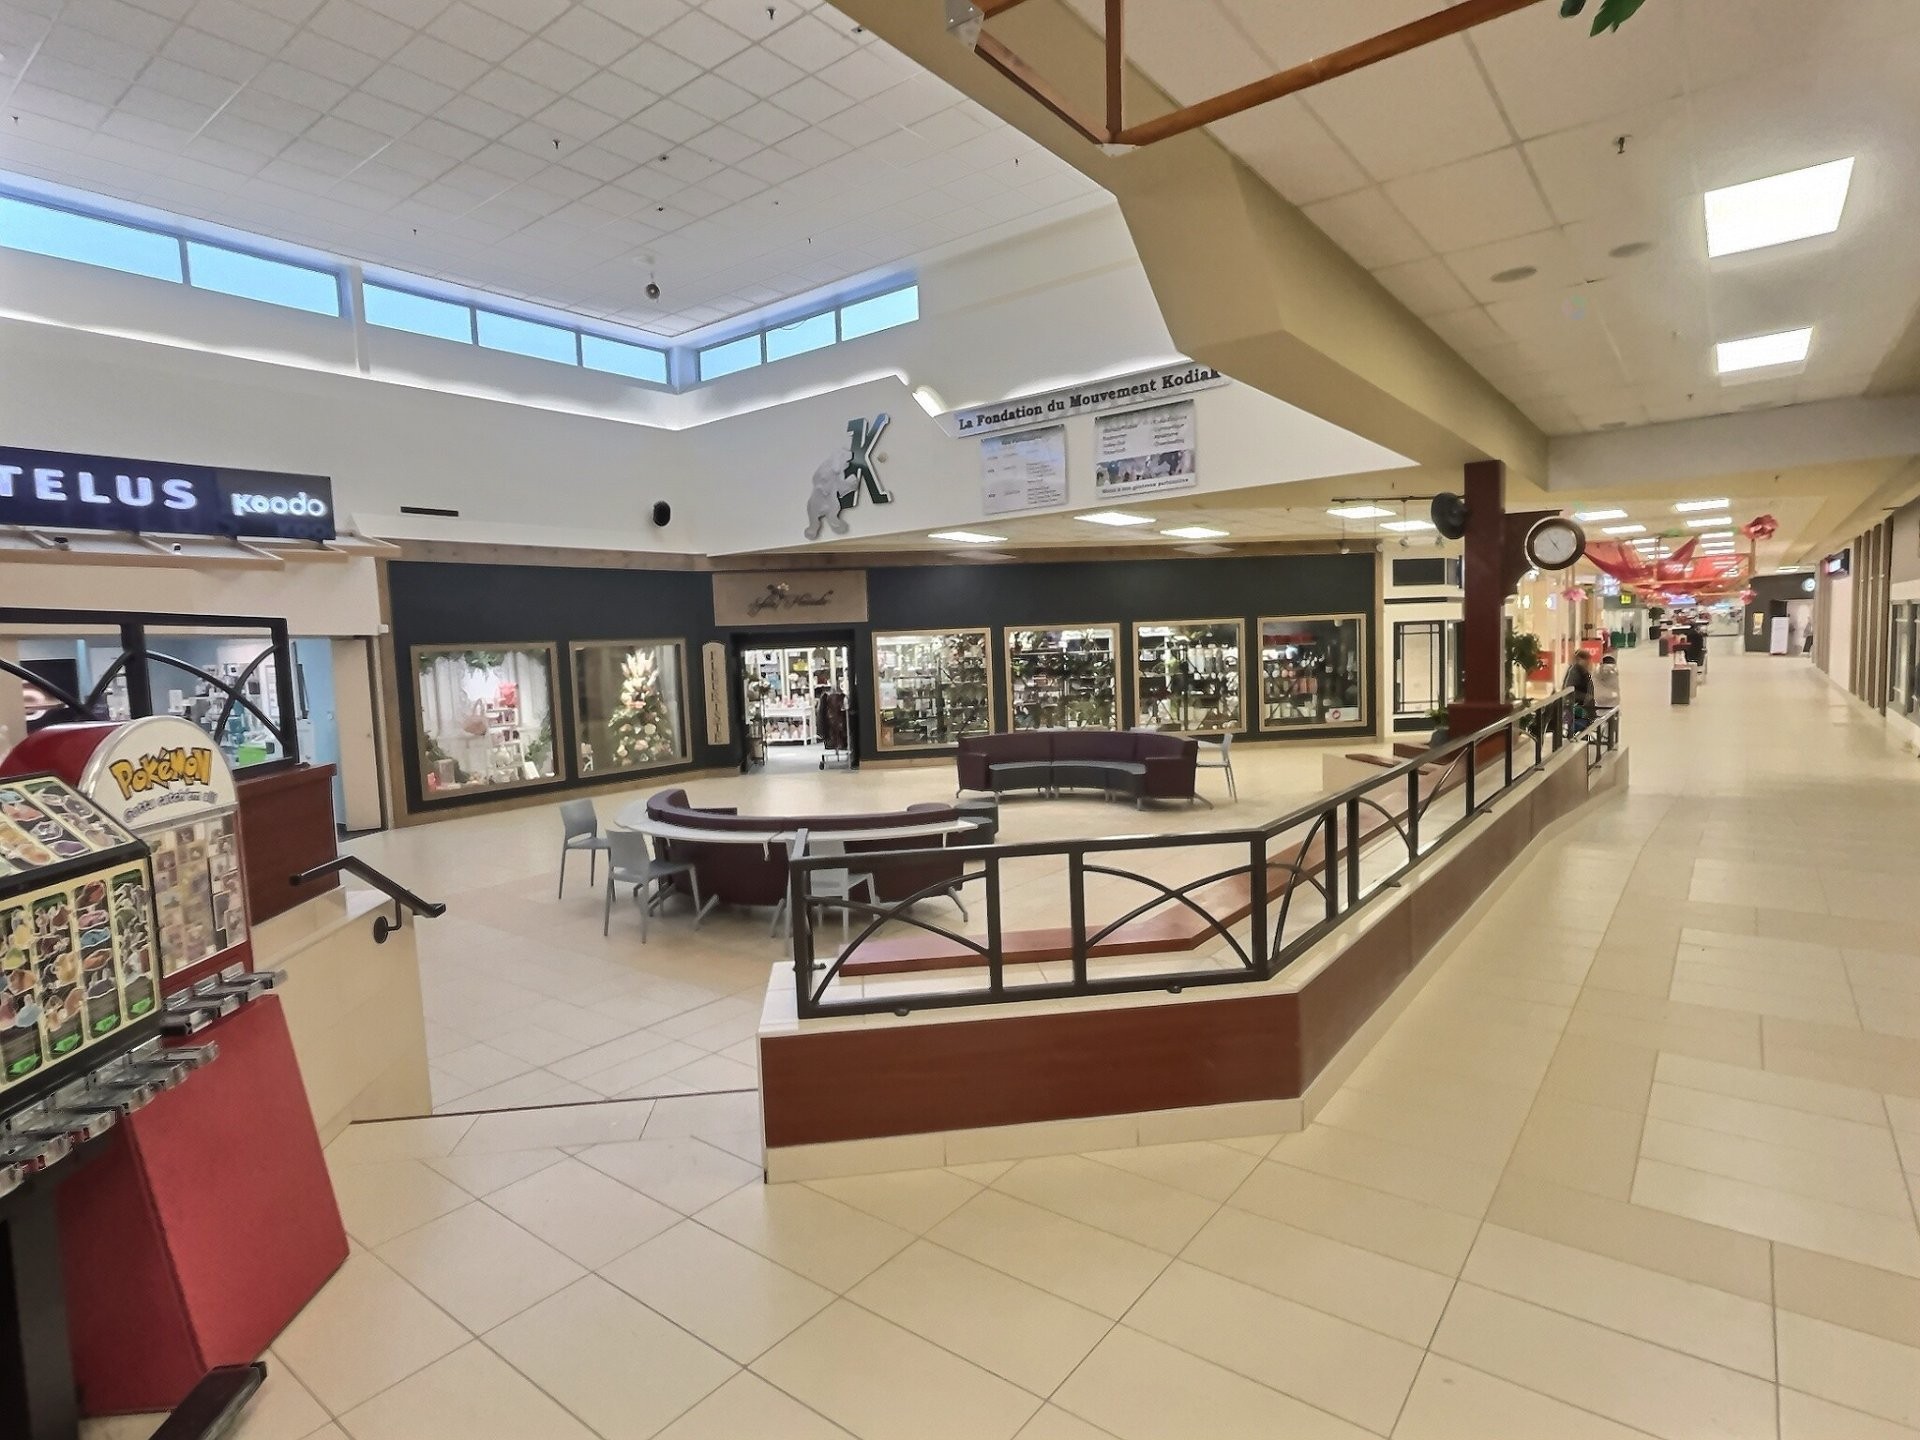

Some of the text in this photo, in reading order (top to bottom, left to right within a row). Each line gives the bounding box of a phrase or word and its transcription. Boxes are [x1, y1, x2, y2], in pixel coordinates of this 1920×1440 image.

[959, 418, 974, 430] La
[977, 404, 1043, 427] Fondation
[1047, 399, 1065, 412] du
[1069, 378, 1157, 408] Mouvement
[0, 464, 199, 510] TELUS
